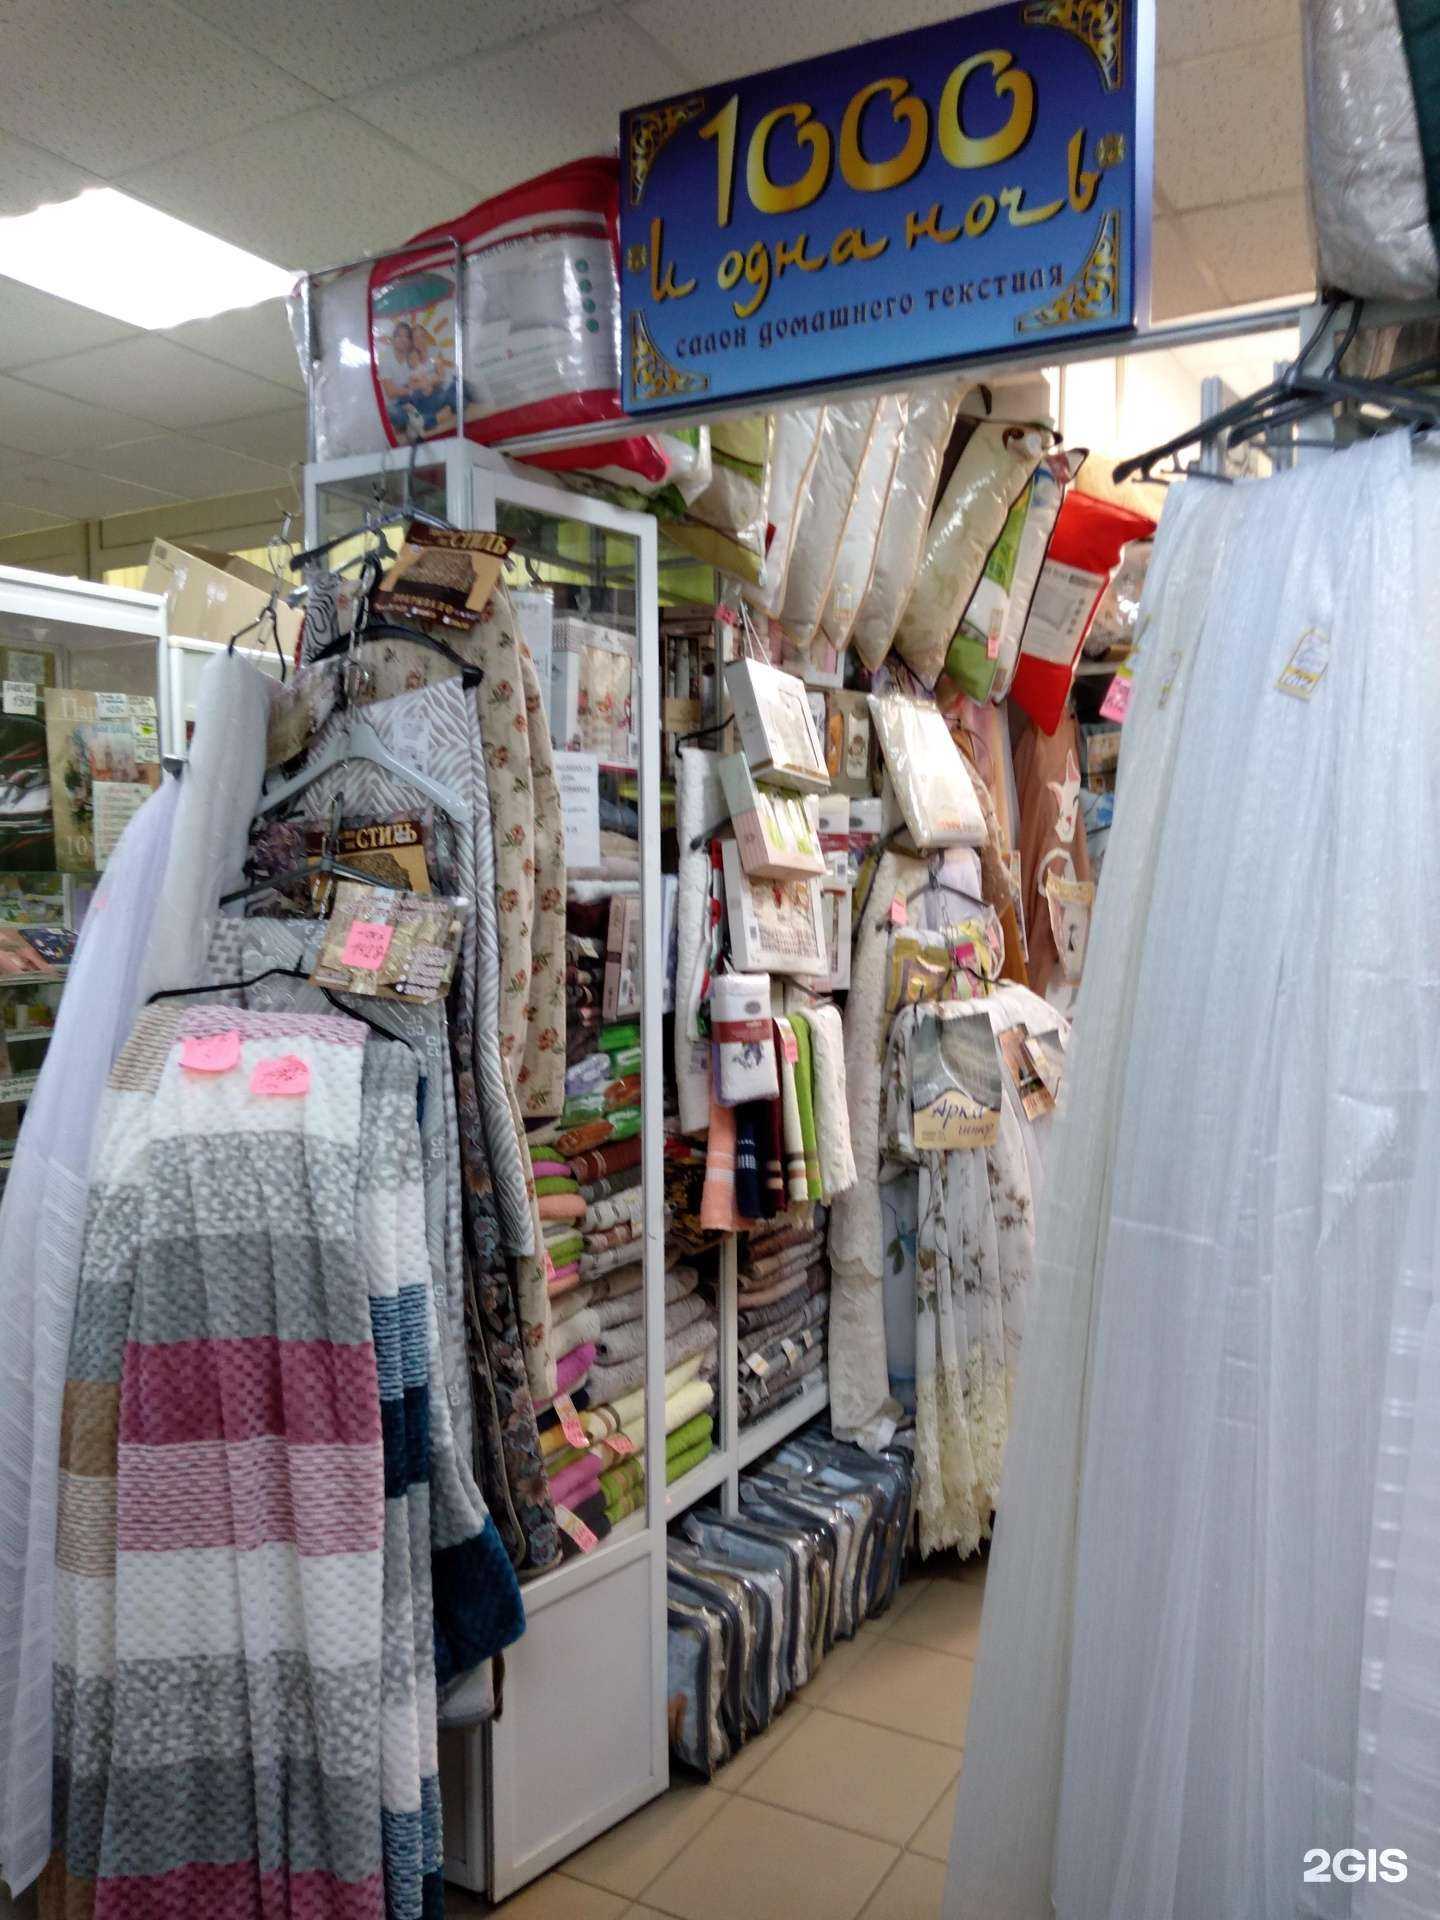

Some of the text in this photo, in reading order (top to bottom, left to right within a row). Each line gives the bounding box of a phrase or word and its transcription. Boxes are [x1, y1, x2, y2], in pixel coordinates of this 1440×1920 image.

[698, 48, 1036, 229] 1000
[717, 229, 889, 318] одна
[905, 128, 1102, 249] ночь
[675, 262, 1064, 359] салон домашнего текстиля
